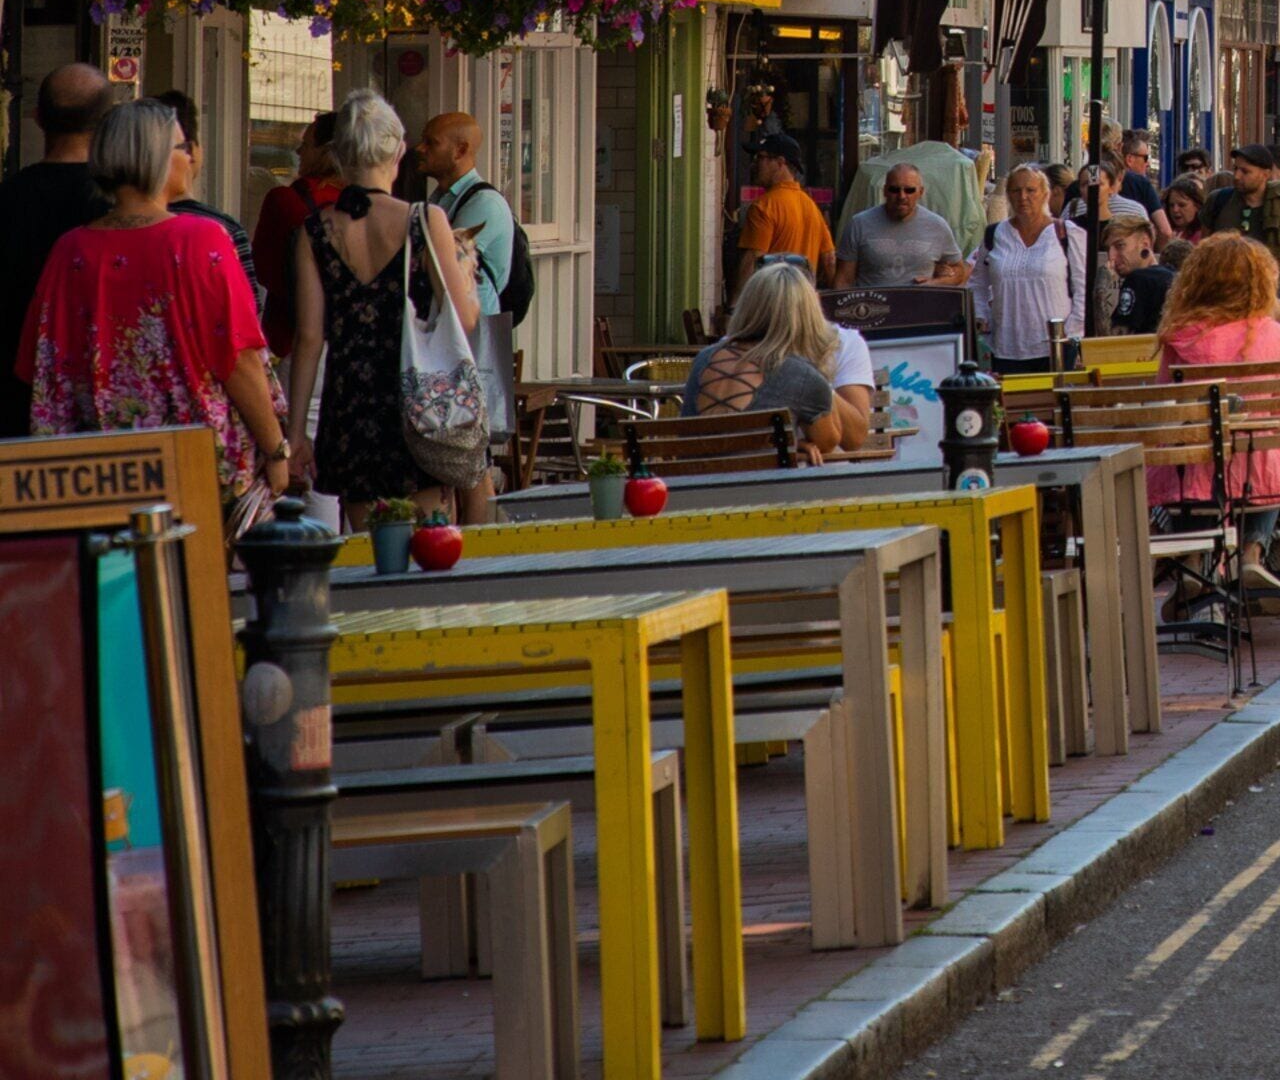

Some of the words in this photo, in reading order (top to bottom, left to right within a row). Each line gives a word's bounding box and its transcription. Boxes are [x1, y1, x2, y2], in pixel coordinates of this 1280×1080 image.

[837, 293, 866, 306] Coffee
[869, 291, 888, 302] Tree
[14, 459, 165, 502] KITCHEN
